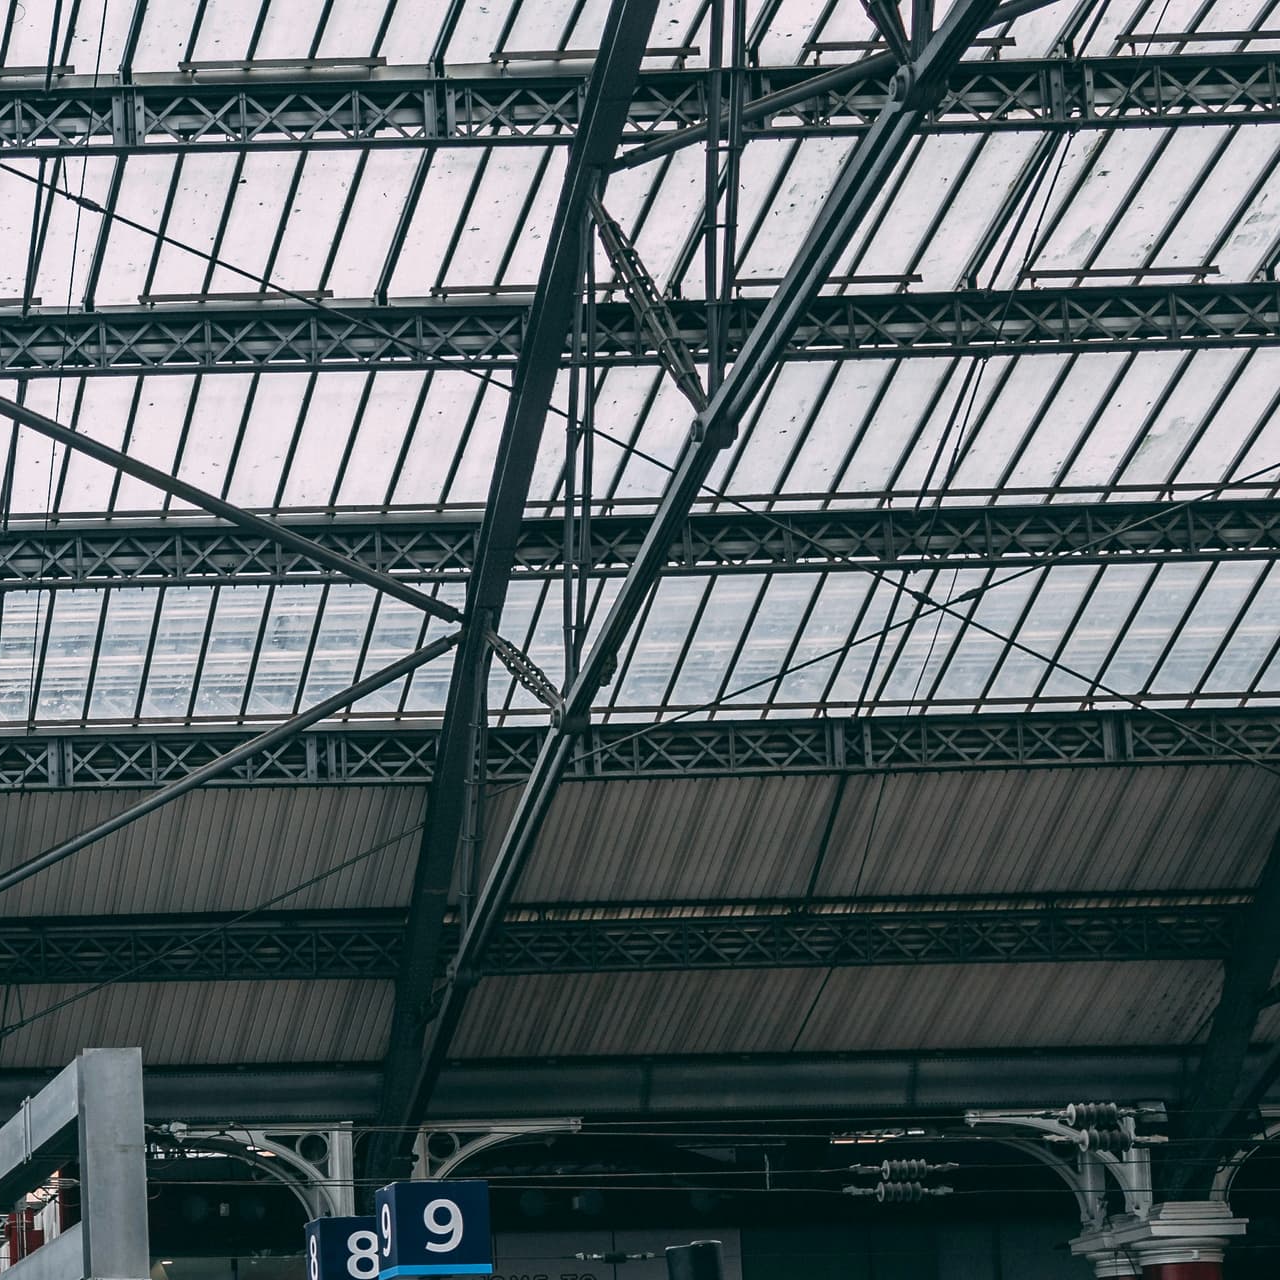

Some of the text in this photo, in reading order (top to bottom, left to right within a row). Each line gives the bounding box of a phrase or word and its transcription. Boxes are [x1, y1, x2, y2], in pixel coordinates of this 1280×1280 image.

[381, 1203, 391, 1258] 9
[423, 1198, 464, 1253] 9
[346, 1230, 379, 1280] 8
